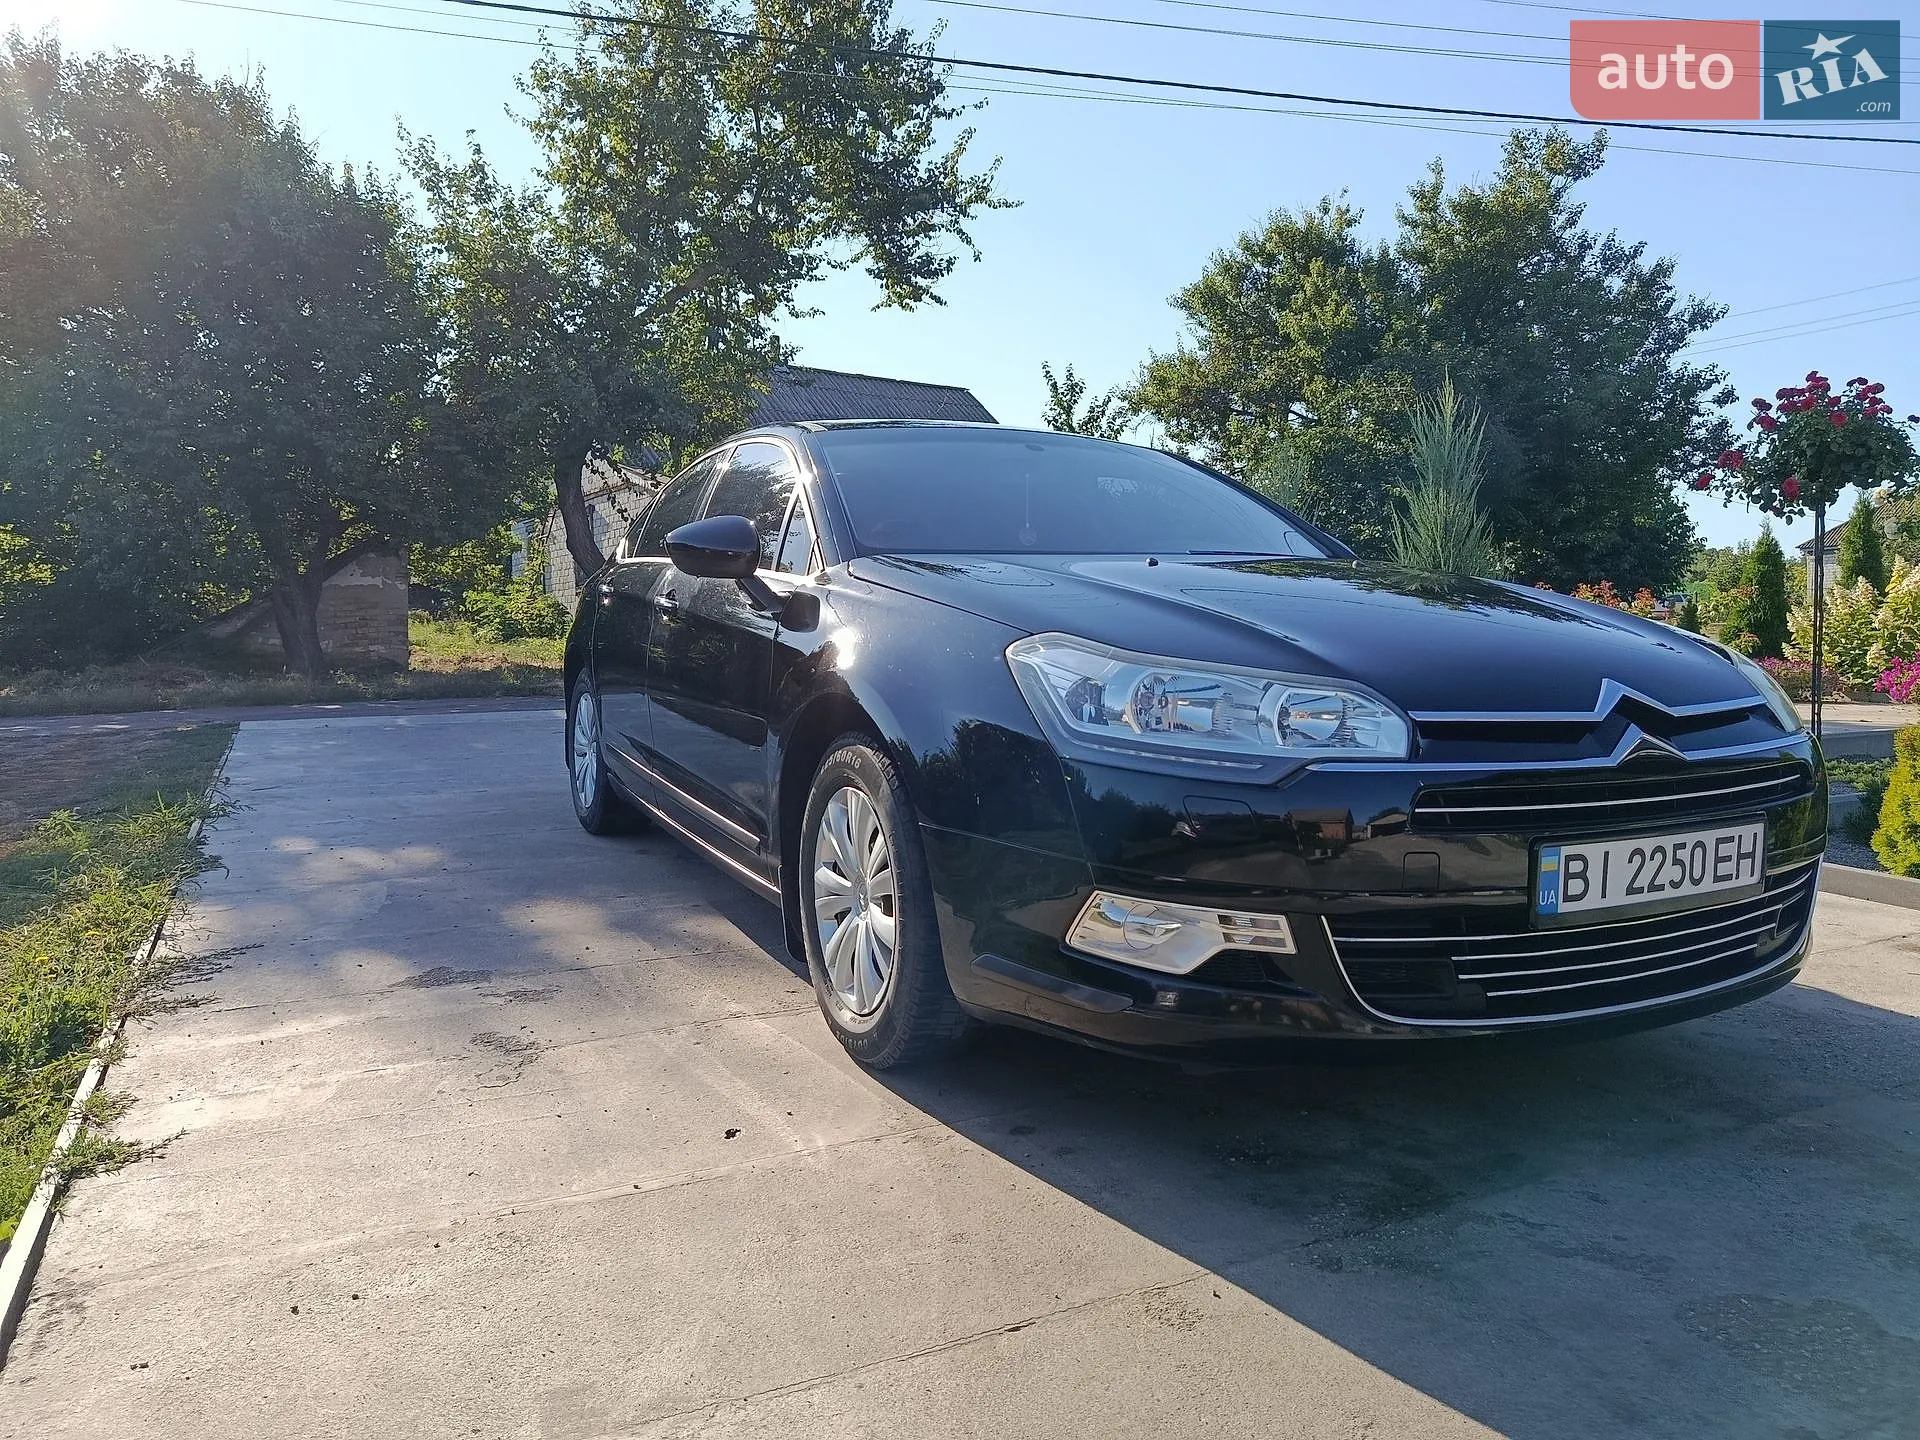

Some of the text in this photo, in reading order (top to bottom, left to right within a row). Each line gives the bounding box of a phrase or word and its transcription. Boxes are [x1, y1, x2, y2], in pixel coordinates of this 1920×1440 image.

[1562, 832, 1758, 904] BI 2250 EH
[1539, 890, 1556, 905] UA
